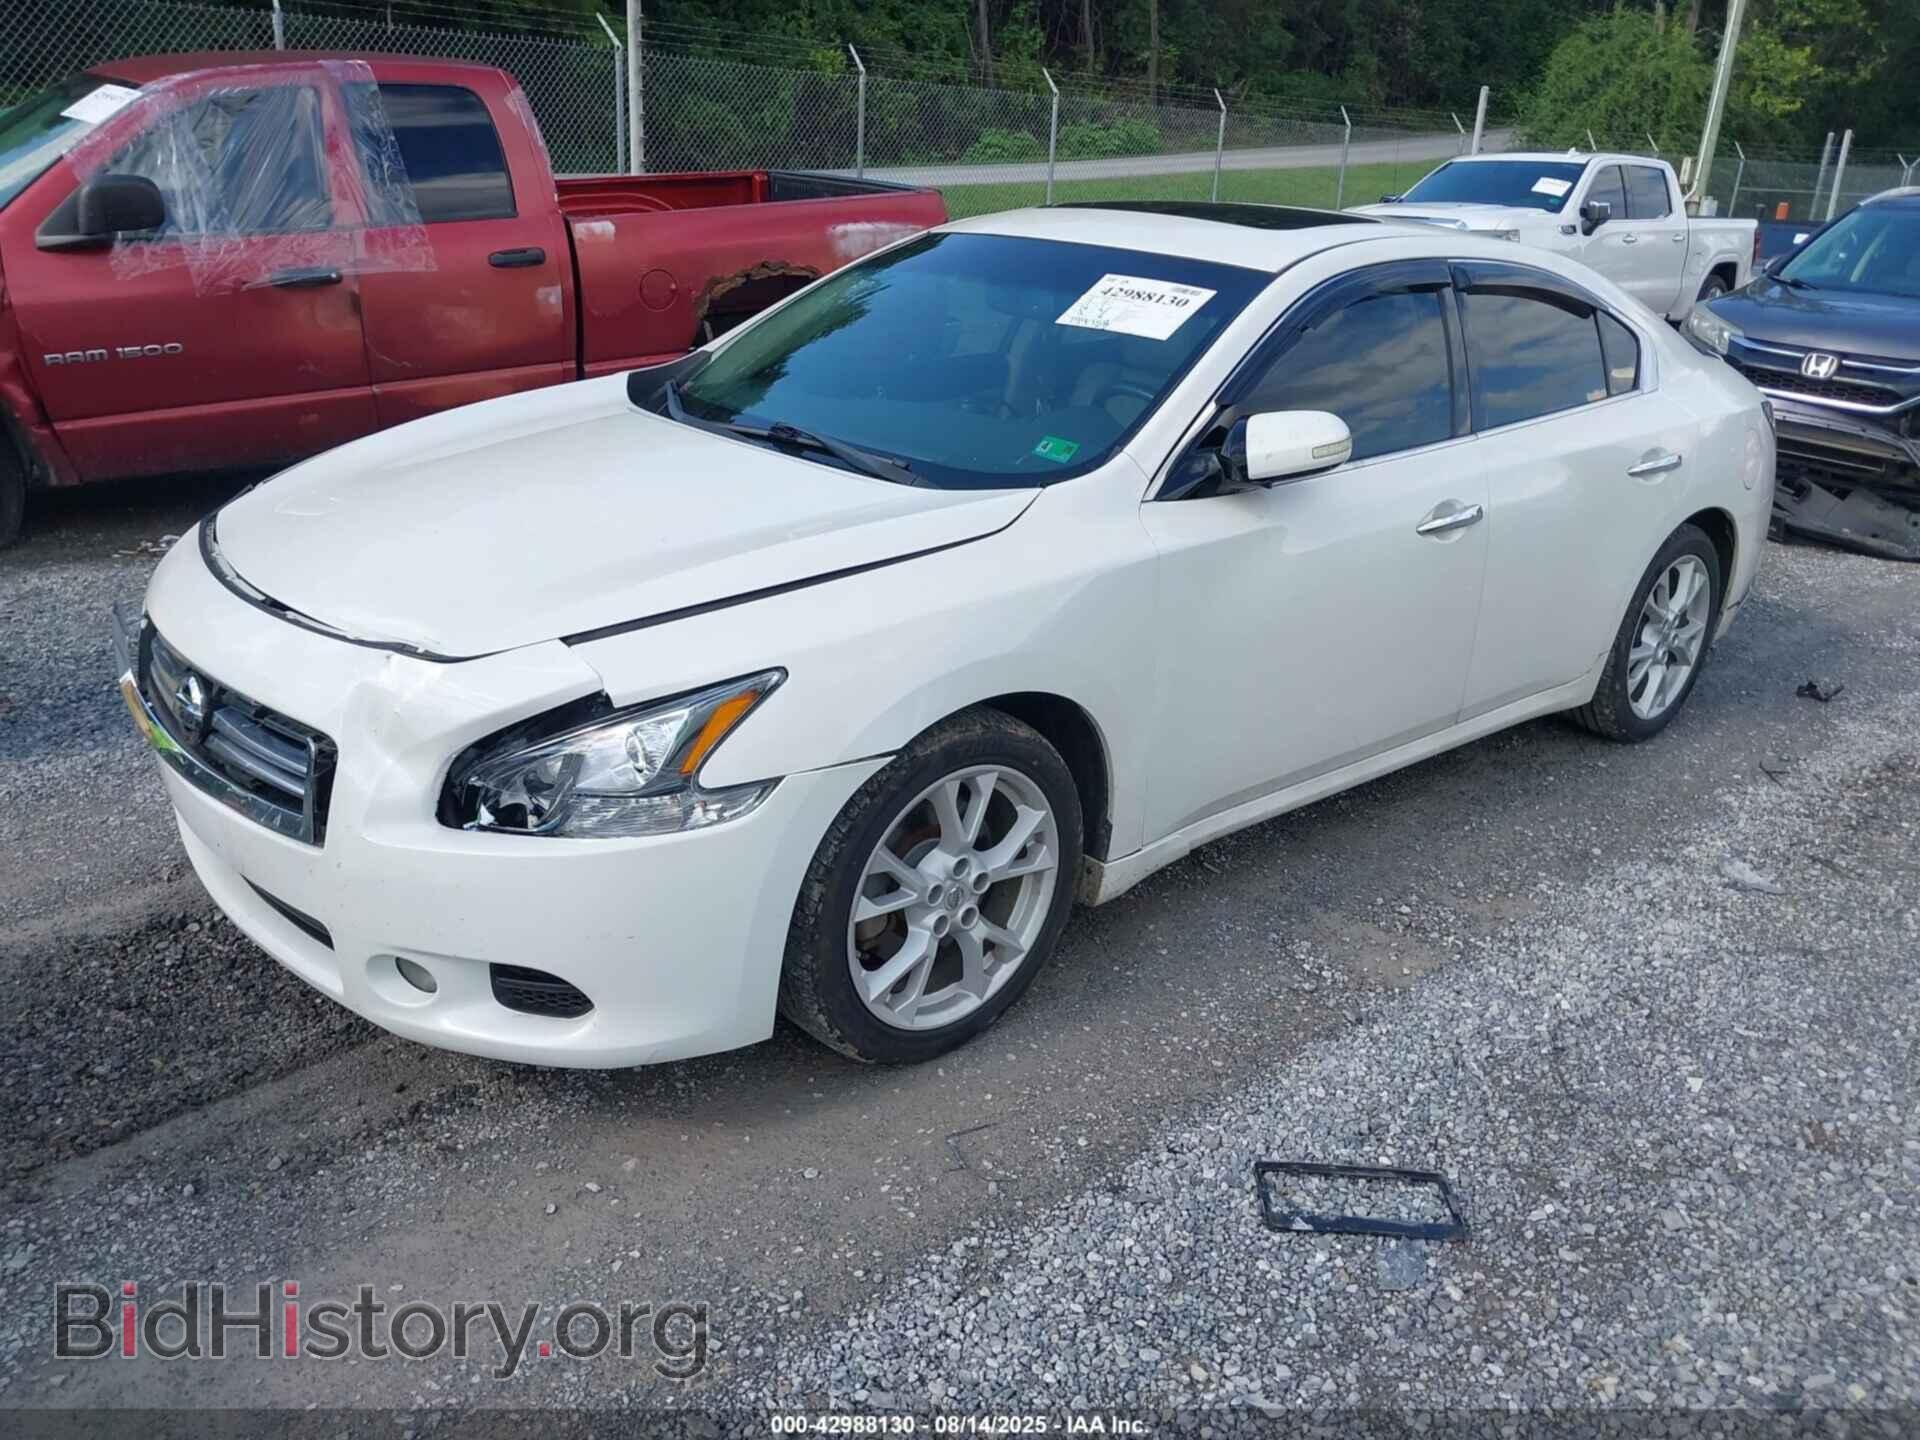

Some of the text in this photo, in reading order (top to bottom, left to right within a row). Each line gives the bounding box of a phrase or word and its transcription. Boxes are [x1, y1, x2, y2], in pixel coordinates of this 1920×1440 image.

[1101, 286, 1190, 308] 42988130
[43, 342, 183, 366] RAM 1500
